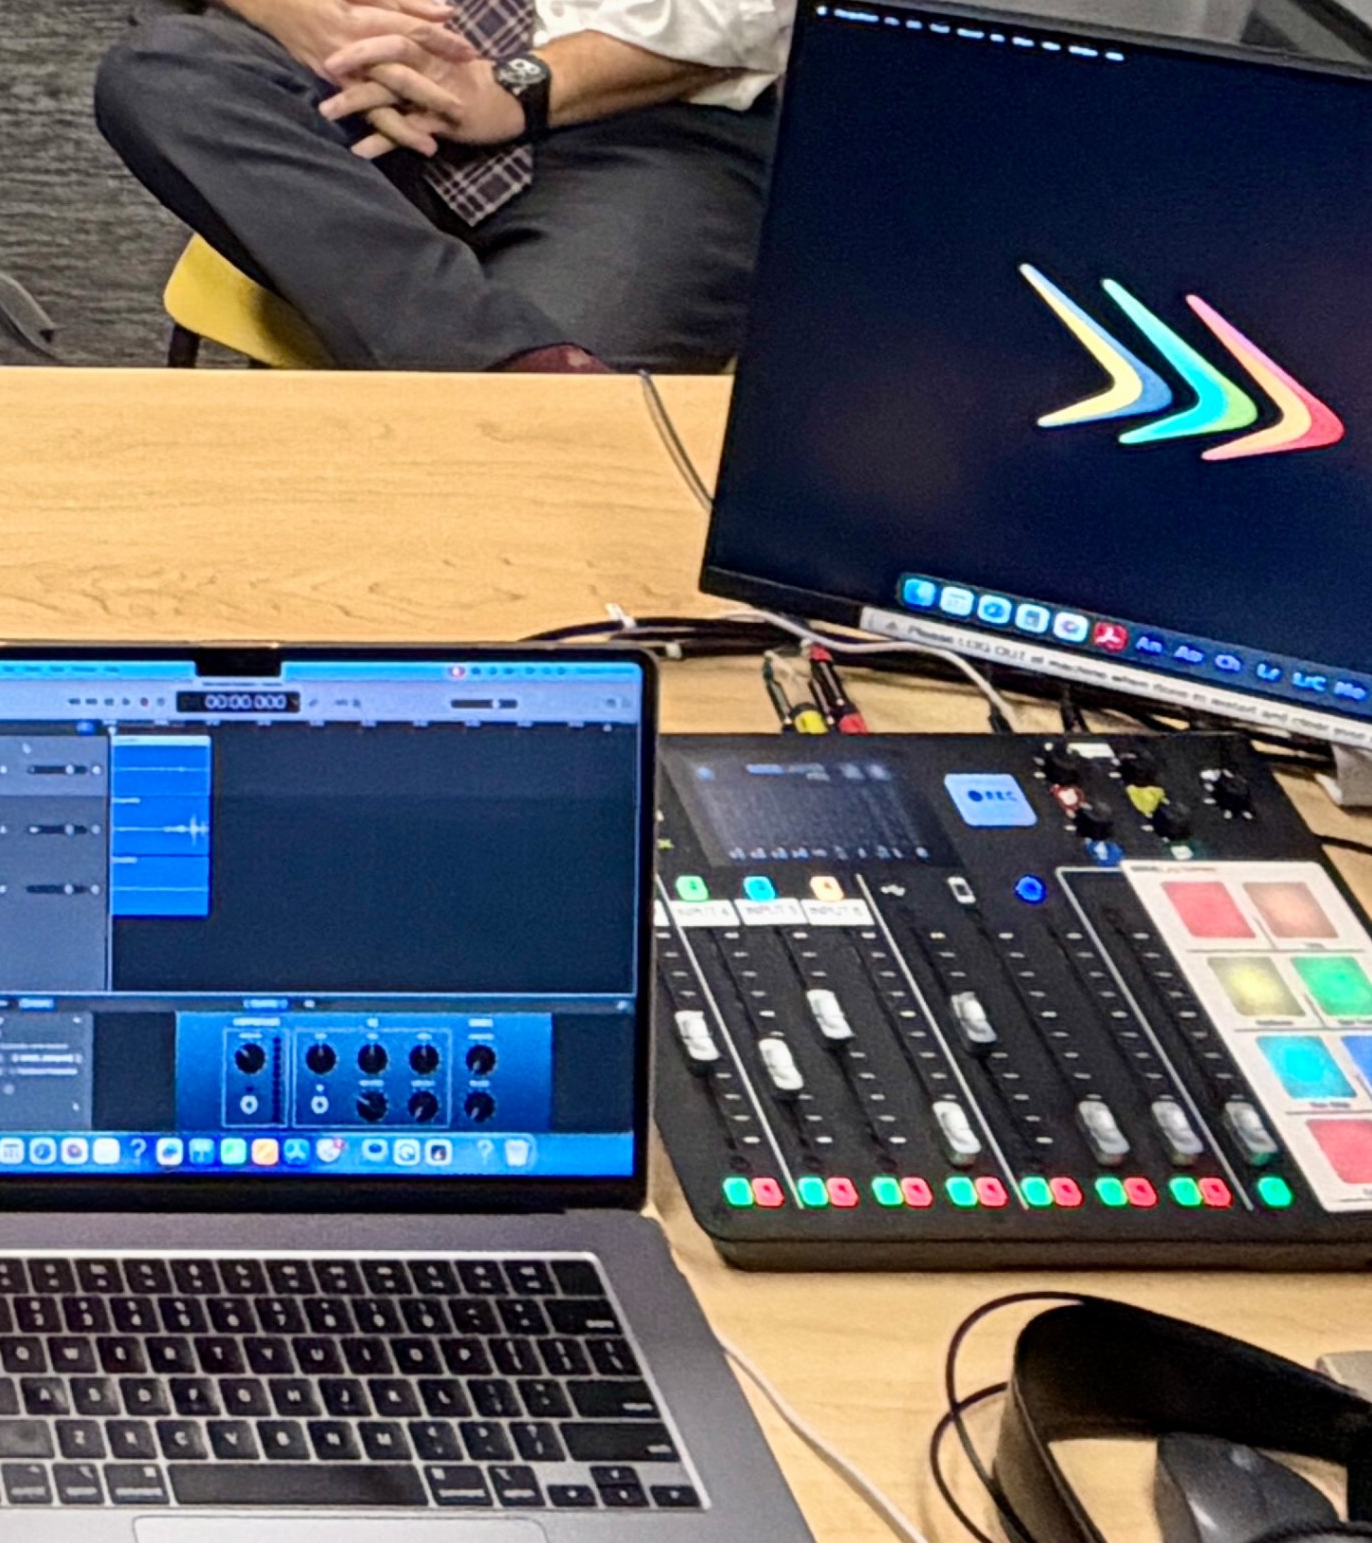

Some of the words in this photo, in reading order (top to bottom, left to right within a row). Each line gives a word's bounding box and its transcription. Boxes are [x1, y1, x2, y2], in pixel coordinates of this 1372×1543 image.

[994, 645, 1027, 662] OUT
[1135, 635, 1164, 654] An
[1257, 662, 1282, 683] Lr
